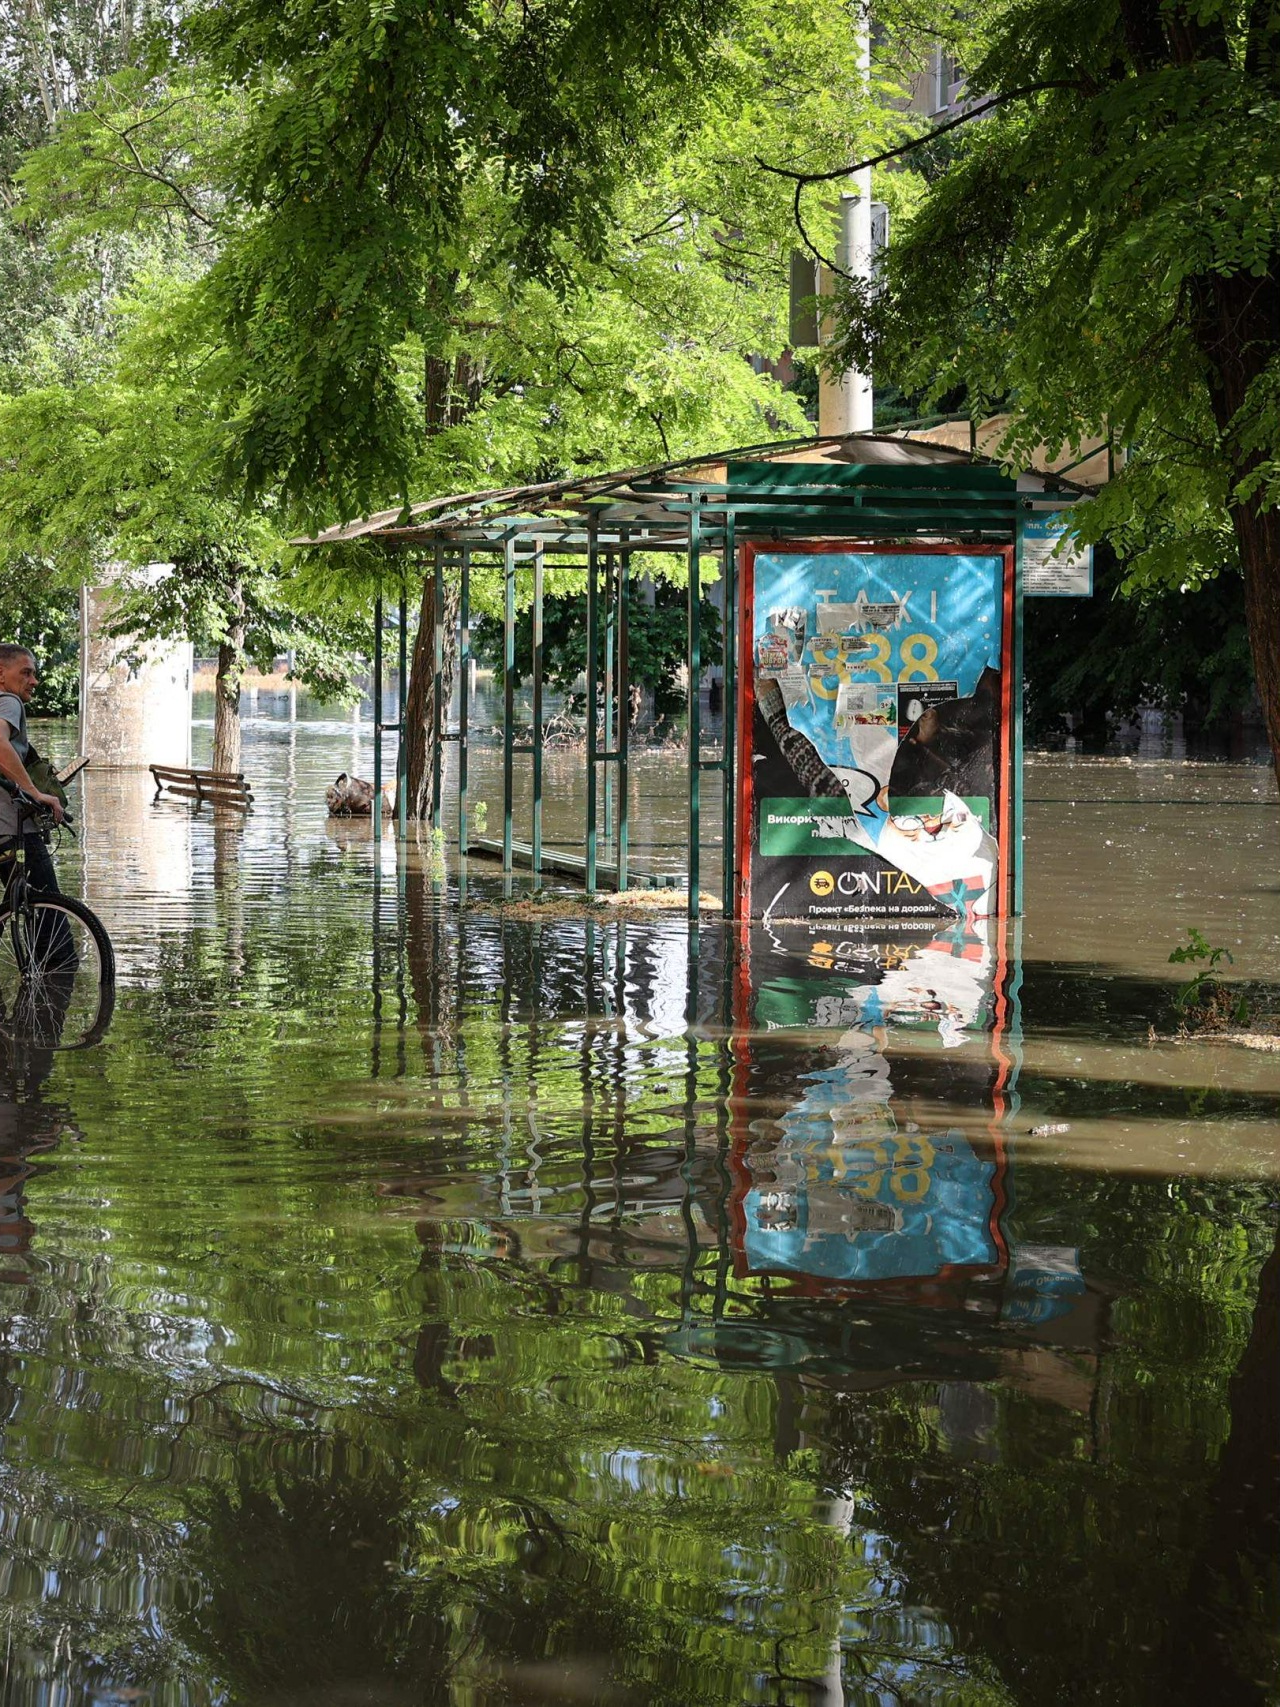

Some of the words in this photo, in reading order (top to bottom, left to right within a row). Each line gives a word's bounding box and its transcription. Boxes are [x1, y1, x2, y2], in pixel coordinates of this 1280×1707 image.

[815, 589, 937, 623] TAXI
[810, 632, 939, 701] 838
[767, 814, 854, 826] Викорис
[808, 905, 842, 914] Проект
[843, 904, 886, 913] «Безпека
[901, 904, 936, 914] дорозі»
